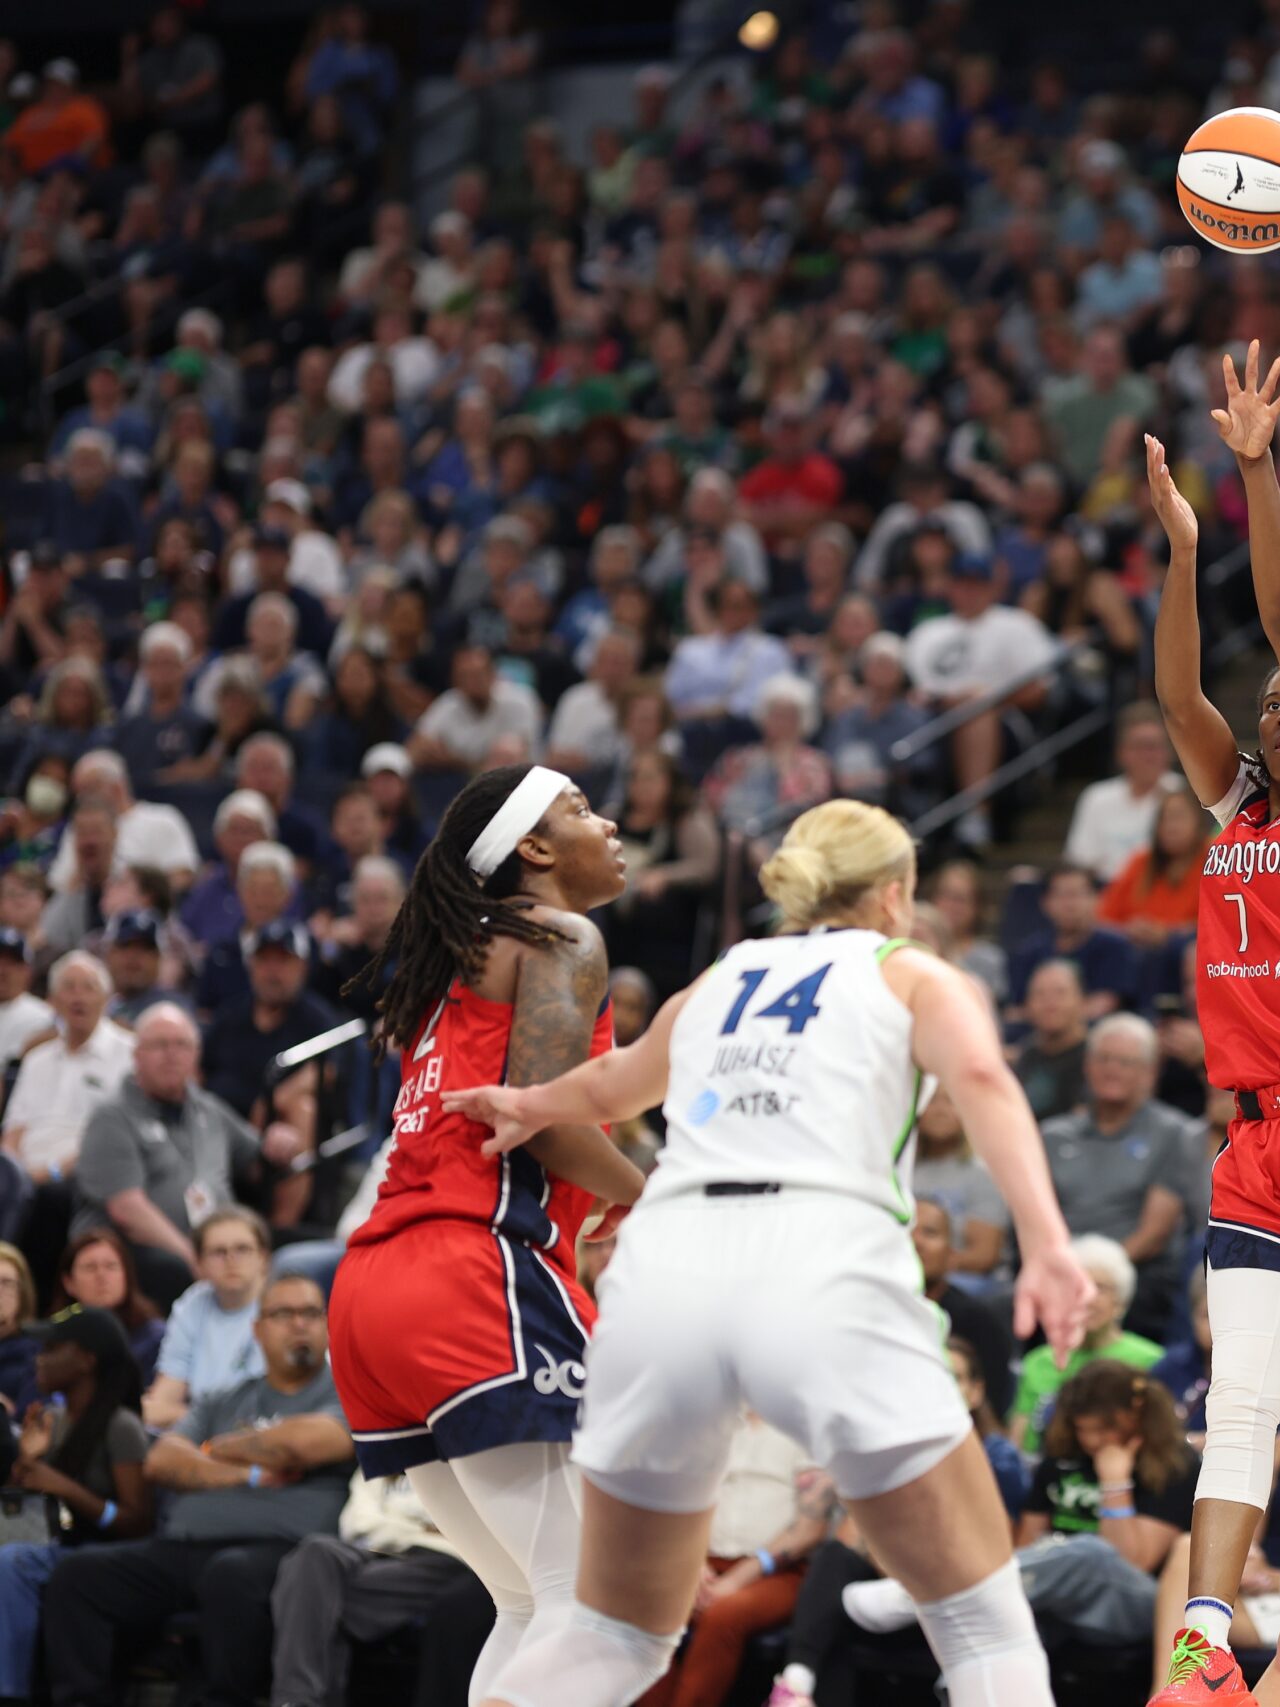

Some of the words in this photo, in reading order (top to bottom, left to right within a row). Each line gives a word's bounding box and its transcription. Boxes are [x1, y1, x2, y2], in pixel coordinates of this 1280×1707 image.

[1190, 202, 1280, 241] Wilson
[1223, 893, 1248, 953] 7
[1206, 960, 1270, 979] Robinhood
[720, 962, 833, 1036] 14
[725, 1091, 803, 1115] AT&T
